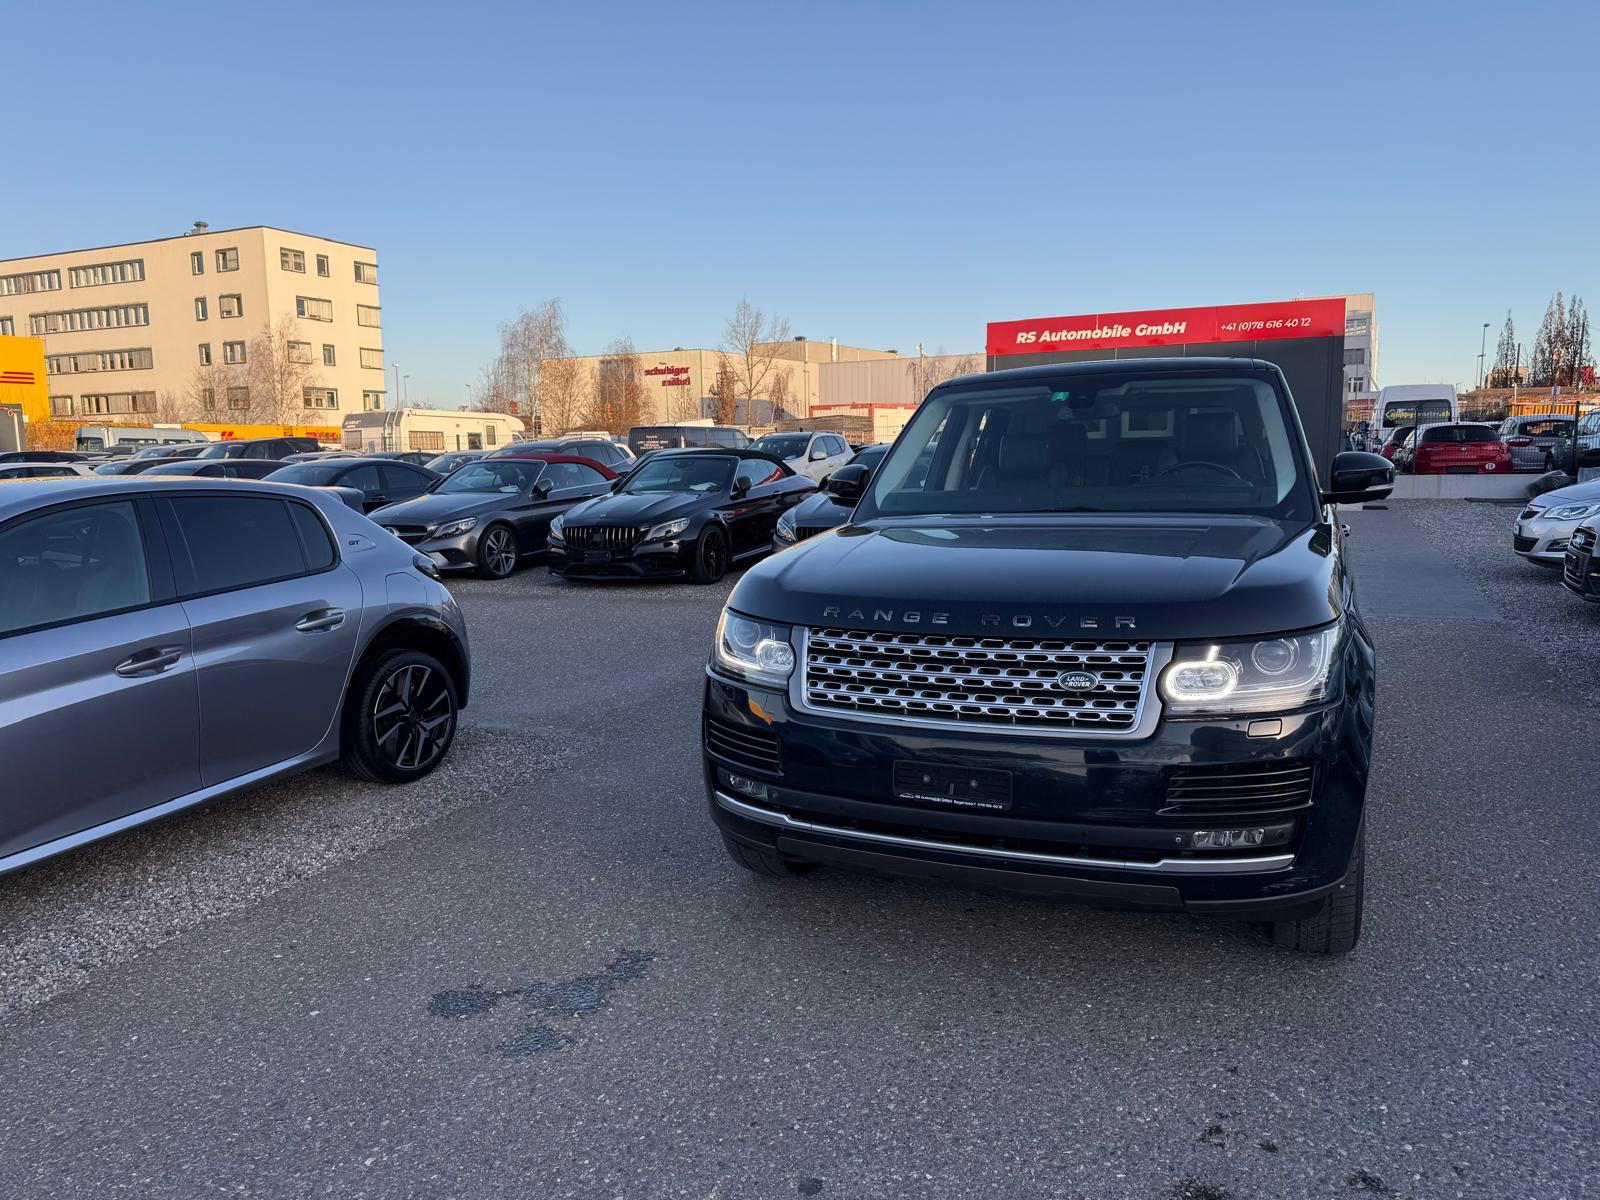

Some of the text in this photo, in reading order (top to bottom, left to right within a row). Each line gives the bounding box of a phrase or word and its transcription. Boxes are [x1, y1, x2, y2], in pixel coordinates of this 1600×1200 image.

[1016, 321, 1187, 344] RS Automobile GmbH
[1220, 317, 1311, 331] +41 (0)78 616 40 12
[823, 606, 1137, 629] RANGE ROVER
